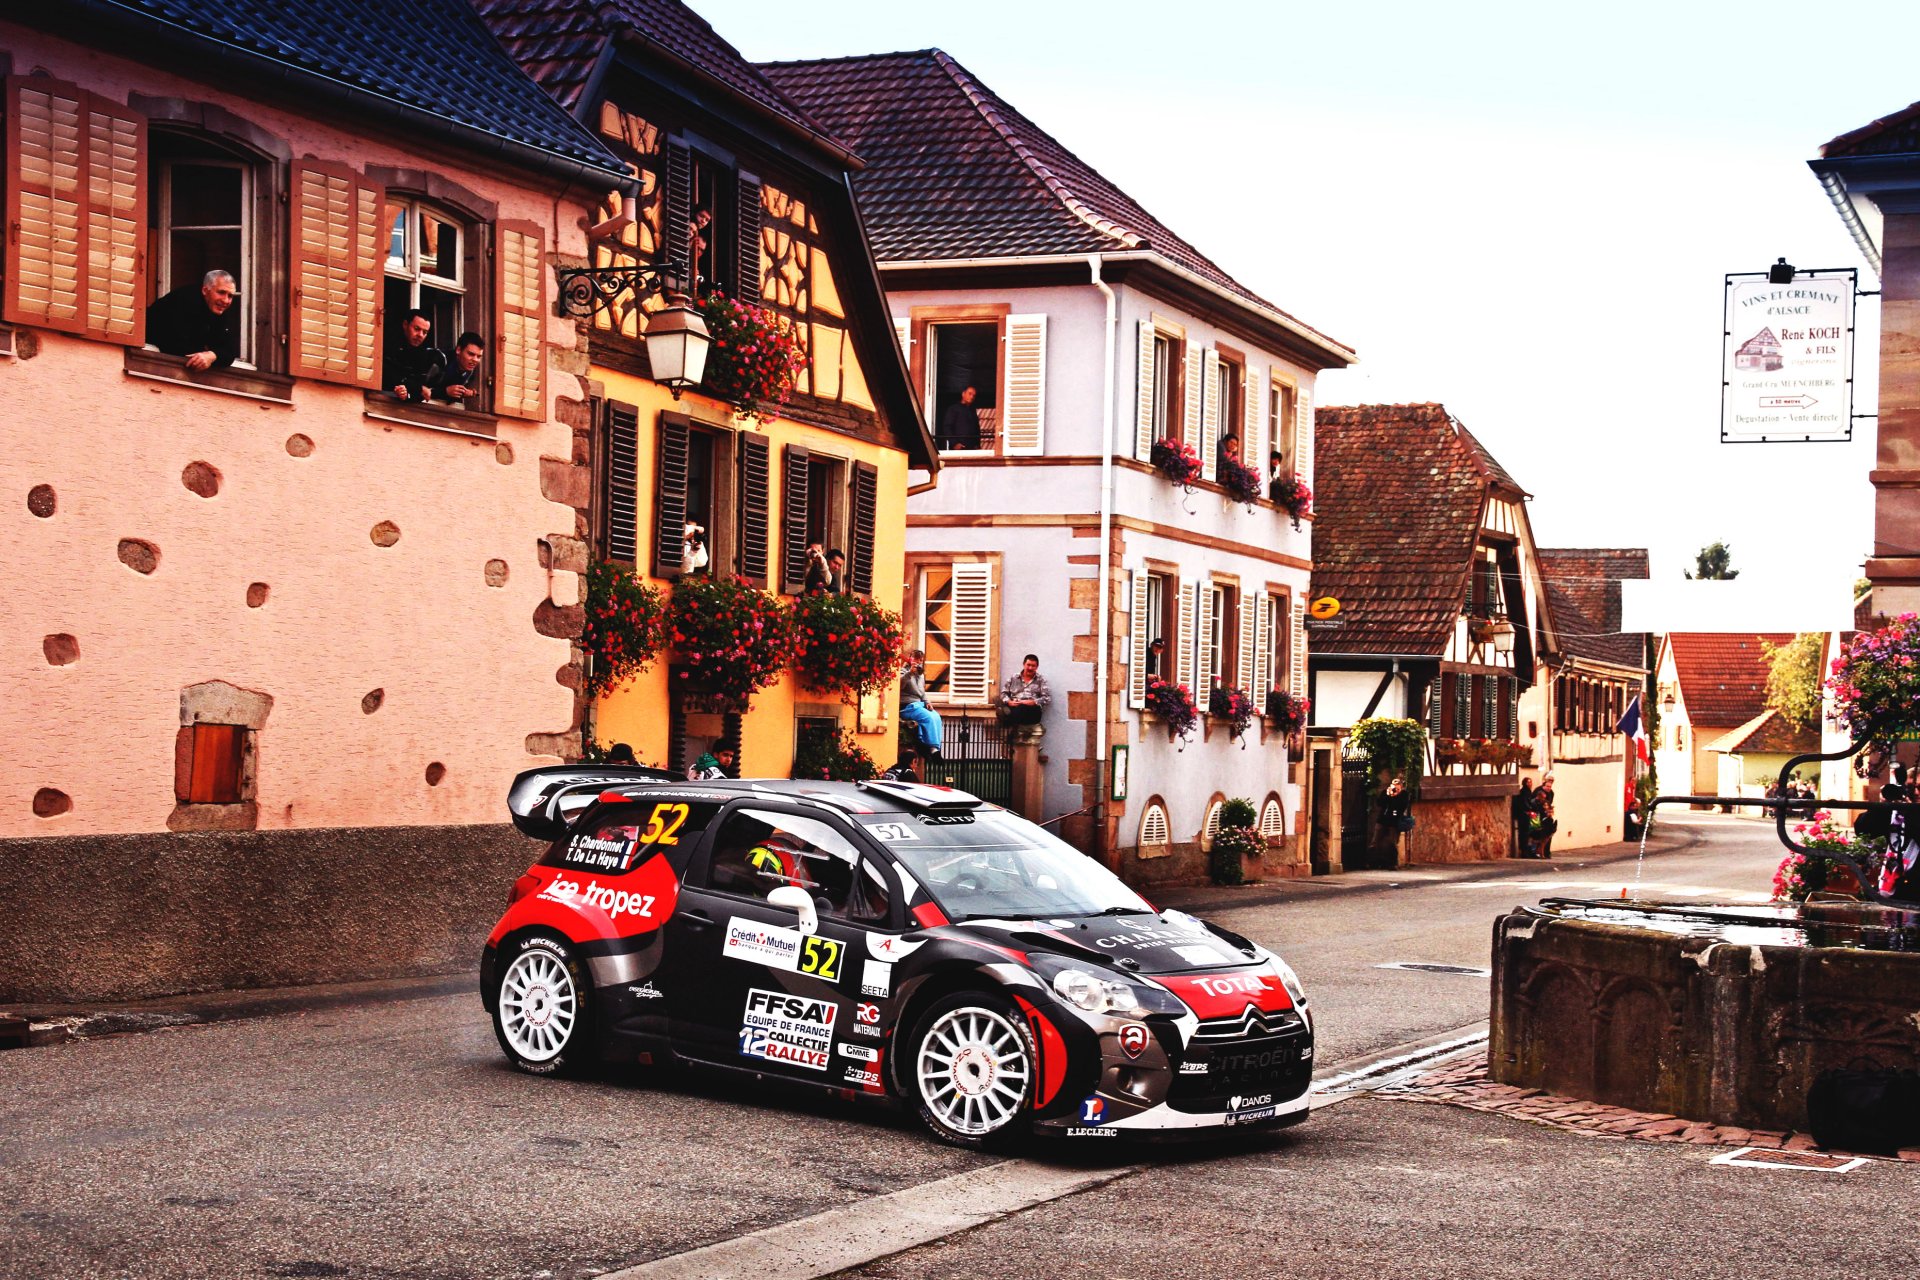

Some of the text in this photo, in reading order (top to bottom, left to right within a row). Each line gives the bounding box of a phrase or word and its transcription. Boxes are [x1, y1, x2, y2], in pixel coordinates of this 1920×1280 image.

[1742, 294, 1767, 307] VINS
[1771, 291, 1782, 300] ET
[1767, 306, 1811, 315] d'ALSACE
[1809, 327, 1840, 340] KOCH
[1816, 346, 1836, 354] FILS
[640, 803, 689, 845] 52
[875, 824, 910, 840] 52
[570, 835, 624, 853] S. Chardonnet
[565, 847, 619, 870] T. De La Haye
[543, 873, 579, 900] ice
[581, 880, 656, 919] tropez
[530, 938, 567, 958] MICHELIN
[731, 927, 796, 952] Crédit Mutuel
[738, 942, 758, 951] banque
[765, 948, 774, 956] qui
[776, 951, 794, 959] parler
[802, 936, 837, 978] 52
[862, 984, 888, 997] SEETA
[1191, 976, 1275, 997] TOTAL
[748, 992, 824, 1024] FFSA
[856, 1003, 881, 1023] RG
[747, 1013, 830, 1038] ÉQUIPE DE FRANCE
[853, 1023, 881, 1038] MATERIAUX
[769, 1031, 828, 1052] COLLECTIF
[766, 1043, 827, 1067] RALLYE
[846, 1045, 870, 1058] CMME
[1241, 1094, 1271, 1107] DANOS
[1238, 1108, 1274, 1121] MICHELIN
[1067, 1128, 1118, 1137] E.LECLERC
